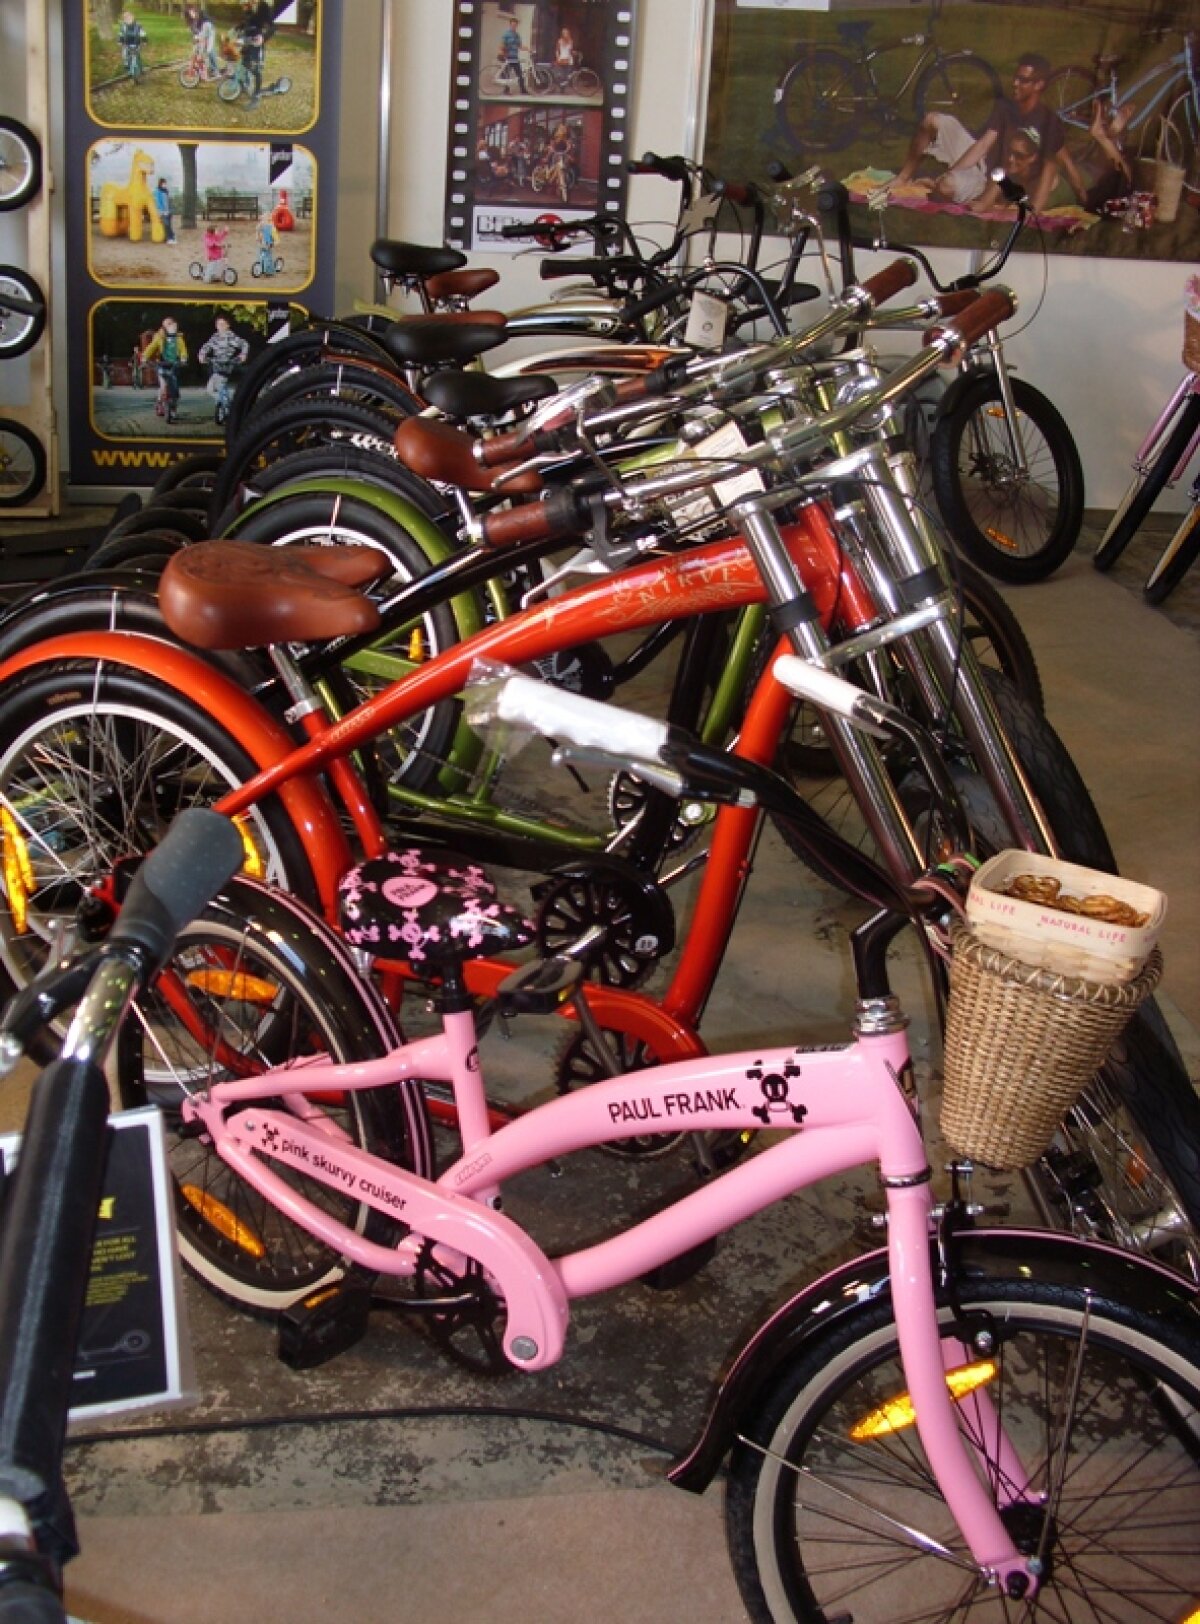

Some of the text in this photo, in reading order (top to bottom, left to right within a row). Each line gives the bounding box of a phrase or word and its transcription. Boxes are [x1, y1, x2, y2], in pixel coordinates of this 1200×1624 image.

[990, 901, 1016, 915] LIFE
[1041, 915, 1091, 935] NATURAL
[1099, 930, 1126, 943] LIFE
[608, 1088, 741, 1123] PAUL FRANK
[282, 1140, 407, 1210] pink skurvy cruiser
